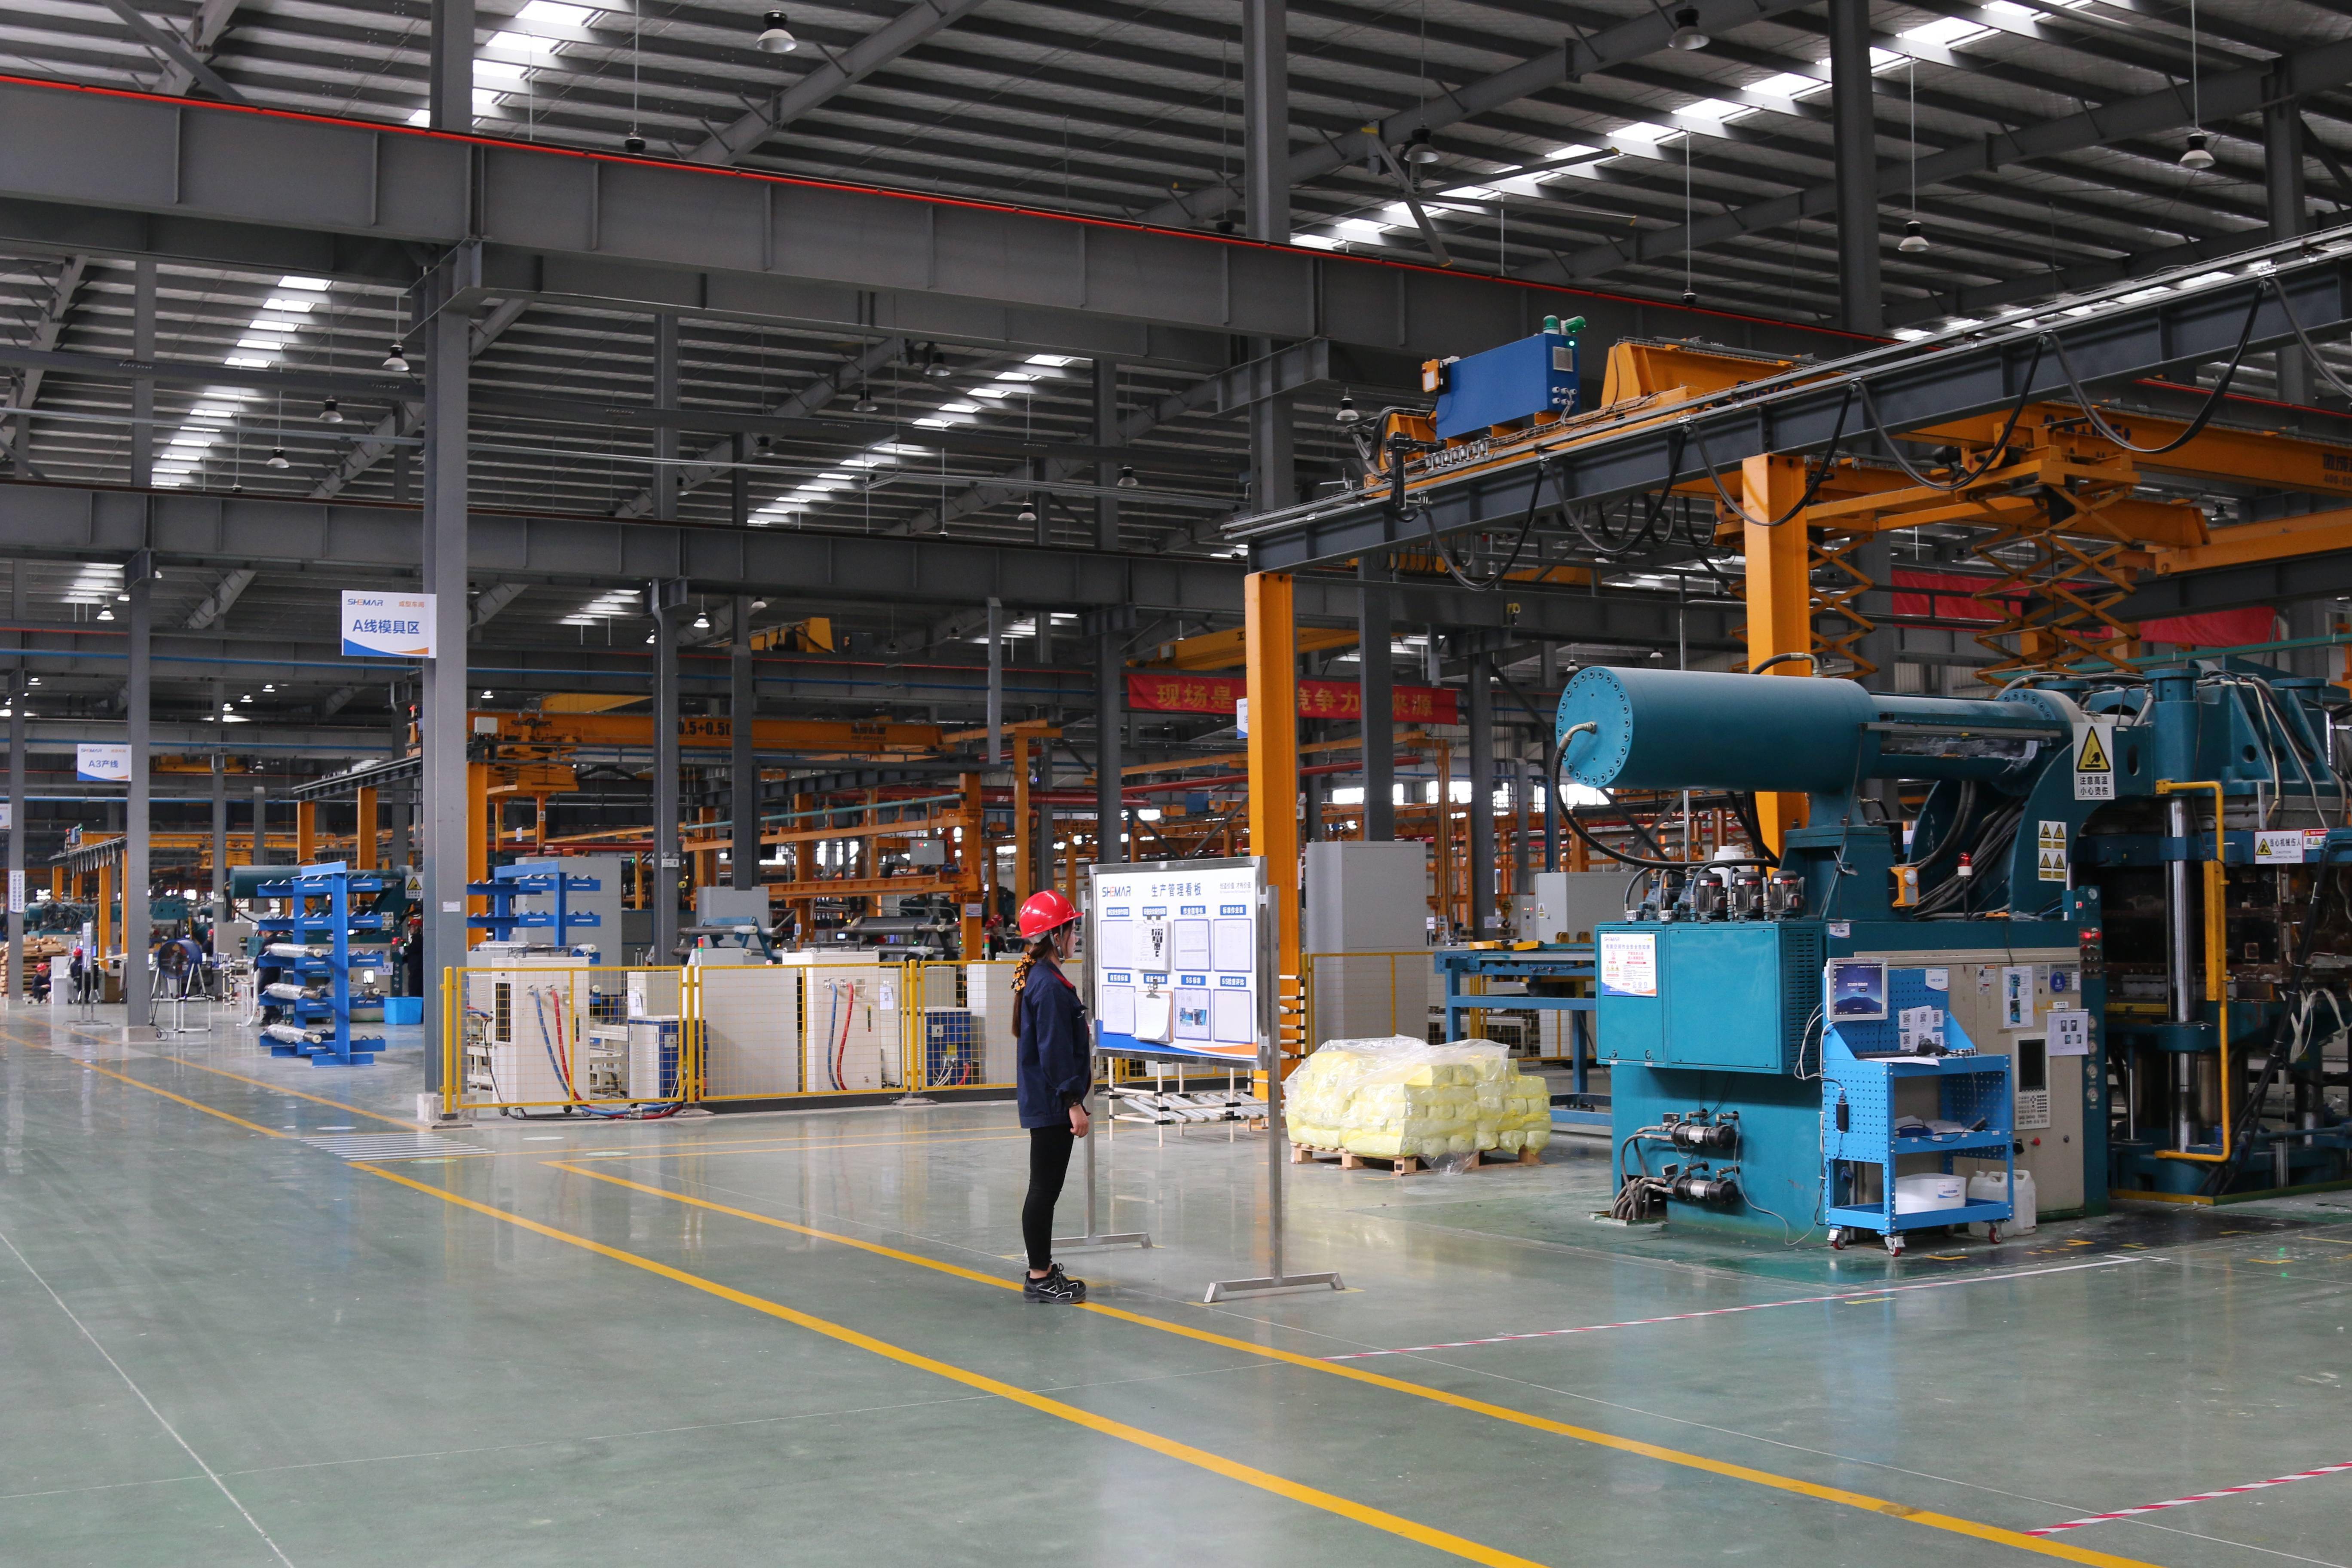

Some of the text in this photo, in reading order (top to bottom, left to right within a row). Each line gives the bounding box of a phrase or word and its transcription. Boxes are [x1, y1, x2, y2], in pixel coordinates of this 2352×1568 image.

[347, 598, 383, 606] SHEMAR
[352, 619, 420, 634] A线模具区
[89, 760, 119, 769] A3产线
[2079, 776, 2108, 785] 注意高温
[2080, 787, 2108, 796] 小心烫伤
[2269, 838, 2302, 847] 当心机械伤人
[1102, 886, 1131, 897] SHEMAR
[1152, 882, 1202, 897] 生产管理看板
